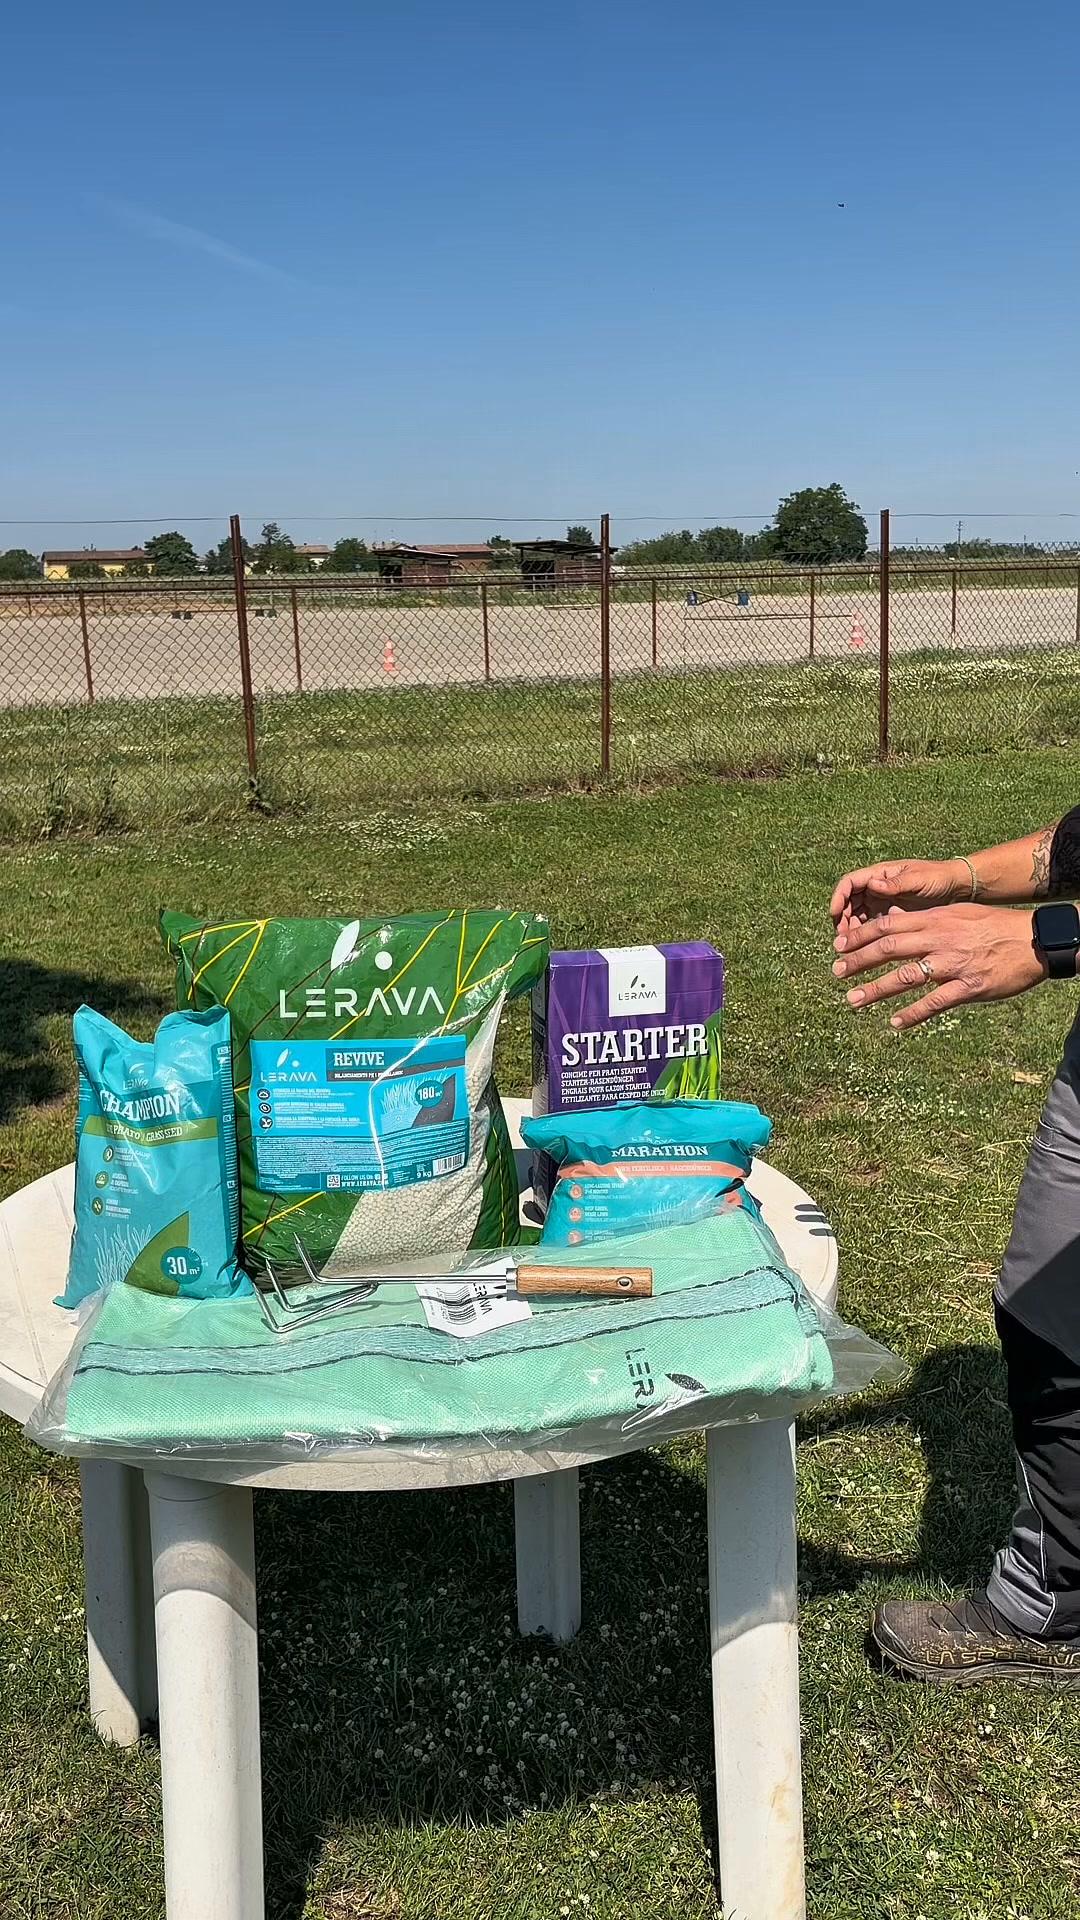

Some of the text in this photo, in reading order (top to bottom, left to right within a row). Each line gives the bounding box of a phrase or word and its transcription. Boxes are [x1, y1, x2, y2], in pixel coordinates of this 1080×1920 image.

[280, 986, 445, 1018] LERAVA
[618, 991, 658, 1001] LERAVA
[561, 1023, 709, 1066] STARTER
[333, 1051, 385, 1067] REVIVE
[260, 1071, 318, 1083] LERAVA
[561, 1066, 647, 1079] CONCIME PER PRATI STARTER
[417, 1086, 435, 1100] 180
[561, 1082, 652, 1096] ENGRAIS POUR GAZON STARTER
[601, 1092, 618, 1101] PARA
[618, 1091, 641, 1099] CÉSPED
[641, 1090, 650, 1098] DE
[99, 1089, 181, 1122] CHAMPION
[146, 1129, 165, 1142] GRASS
[165, 1126, 183, 1139] SEED
[611, 1144, 709, 1158] MARATHON
[422, 1170, 432, 1178] kg
[166, 1256, 187, 1275] 30
[625, 1347, 655, 1408] LER
[926, 1650, 955, 1665] LA
